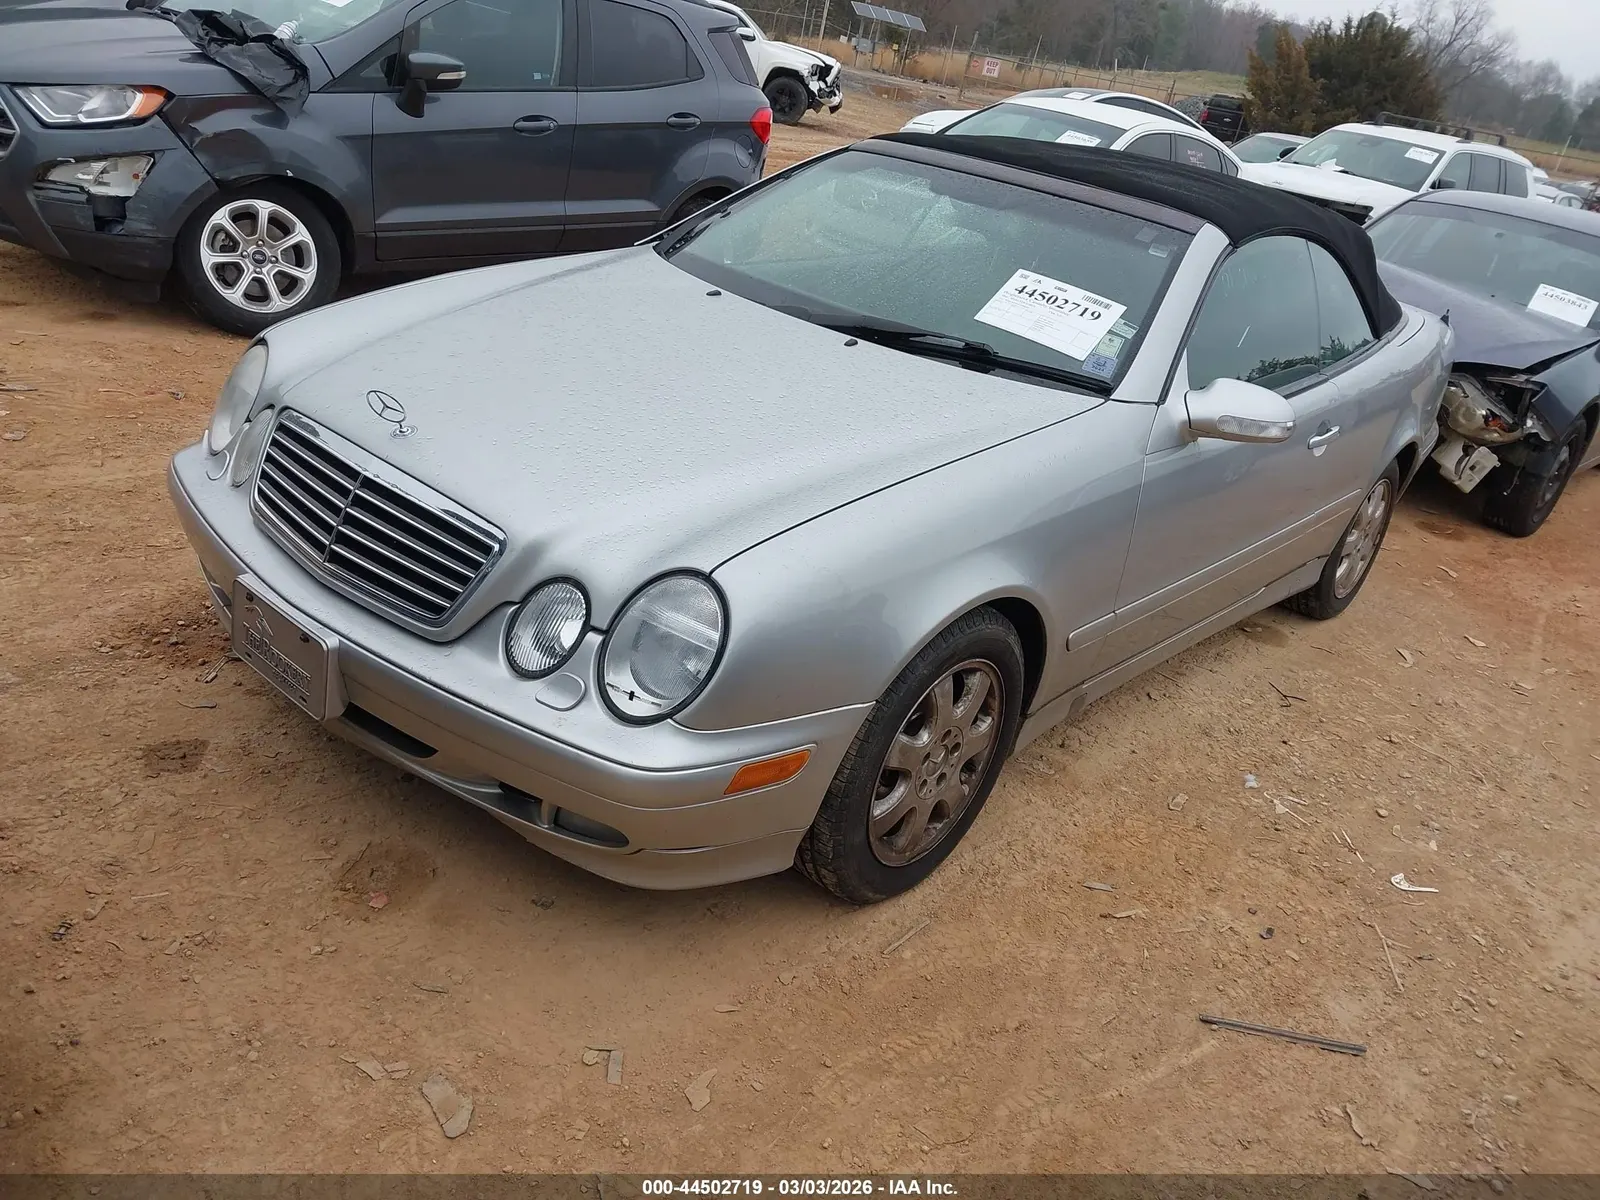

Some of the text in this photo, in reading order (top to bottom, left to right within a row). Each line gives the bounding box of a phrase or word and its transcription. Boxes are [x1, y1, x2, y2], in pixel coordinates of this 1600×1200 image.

[987, 60, 999, 68] KEEP
[986, 67, 996, 75] OUT
[1014, 284, 1103, 321] 44502719
